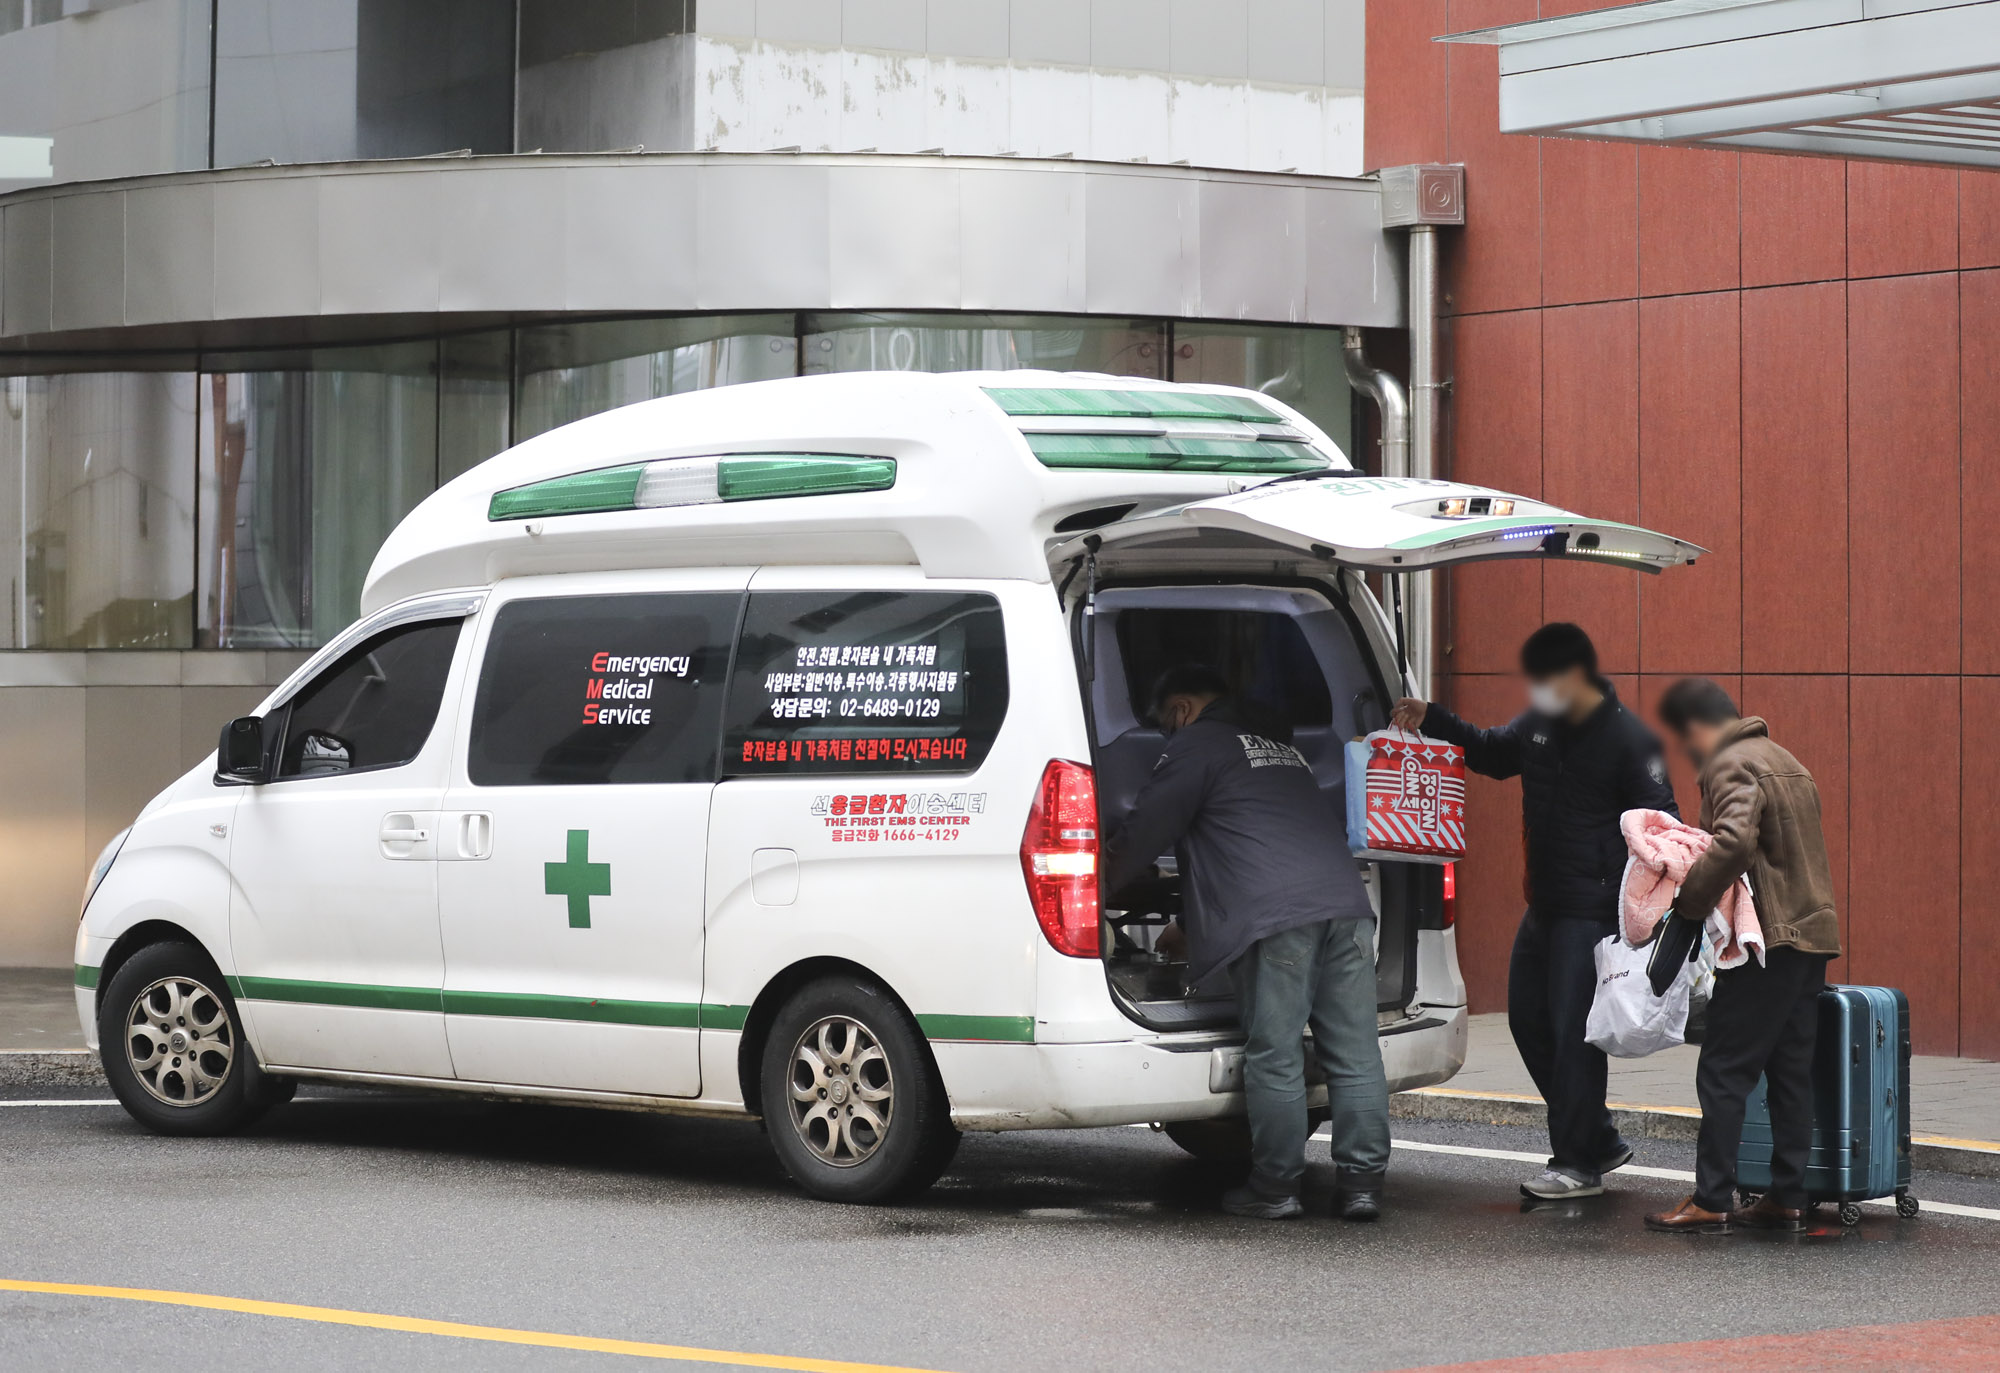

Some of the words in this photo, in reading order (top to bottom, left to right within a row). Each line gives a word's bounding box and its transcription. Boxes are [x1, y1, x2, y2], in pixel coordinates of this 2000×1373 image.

[591, 652, 690, 677] Emergency
[883, 645, 894, 666] 내
[896, 645, 937, 666] 가족처럼
[586, 678, 653, 699] Medical
[582, 703, 651, 725] Service
[770, 697, 832, 718] 상담문의:
[839, 698, 941, 717] 02-6489-0129
[742, 739, 788, 762] 환자분을
[791, 740, 802, 762] 내
[805, 739, 852, 761] 가족처럼
[854, 738, 891, 761] 친절히
[893, 737, 967, 760] 모시겠습니다
[824, 817, 847, 827] THE
[850, 816, 886, 826] FIRST
[888, 816, 917, 826] EMS
[919, 815, 971, 825] CENTER
[831, 829, 880, 842] 응급전화
[883, 828, 960, 841] 1666-4129
